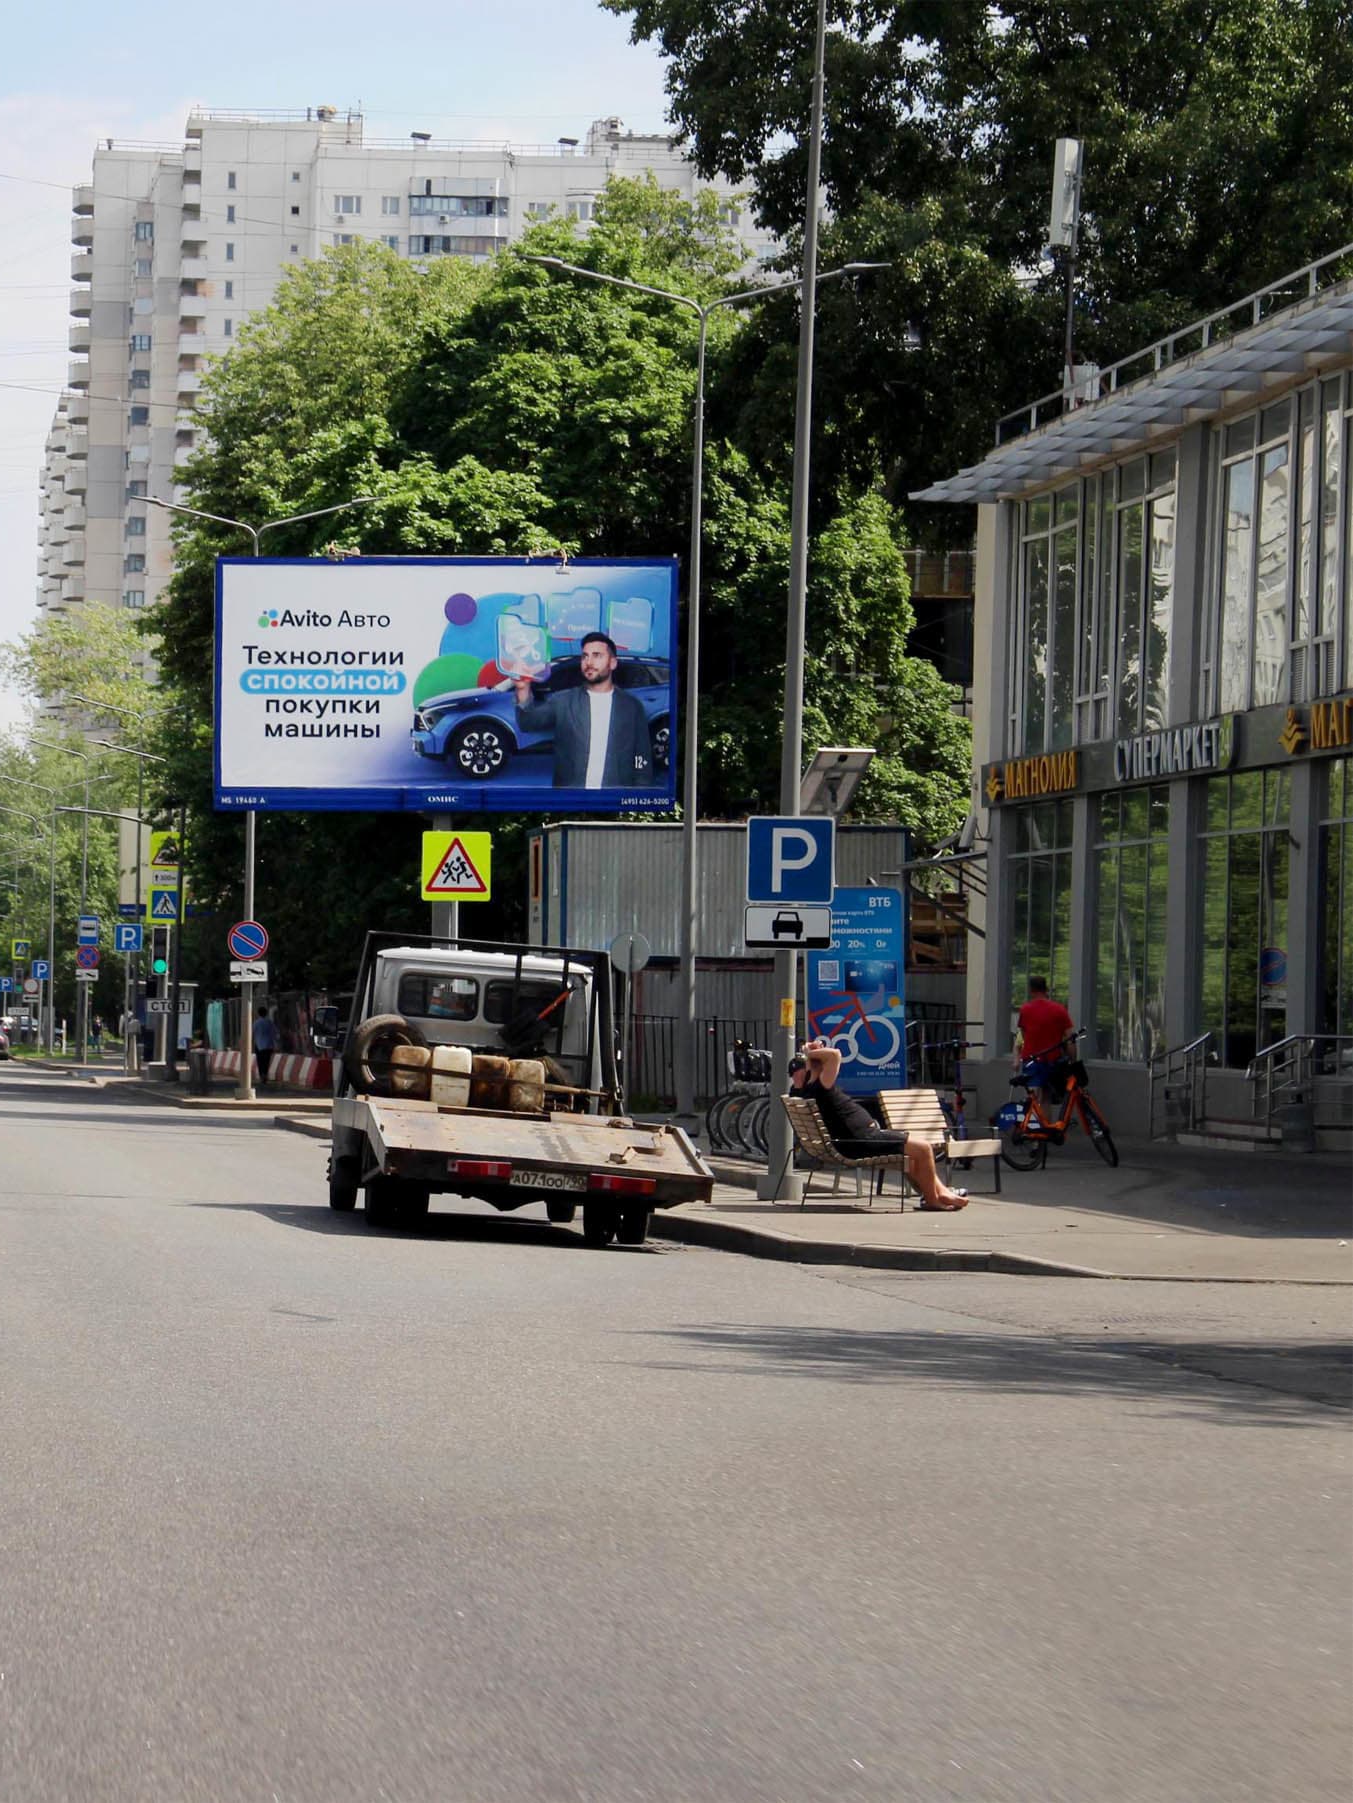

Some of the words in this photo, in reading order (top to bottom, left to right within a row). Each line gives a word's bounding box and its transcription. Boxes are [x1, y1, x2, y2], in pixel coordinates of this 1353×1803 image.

[280, 609, 332, 627] Avito
[337, 610, 391, 628] Авто
[242, 645, 405, 665] Технологии
[247, 669, 399, 690] спокойной
[265, 699, 381, 719] покупки
[264, 723, 381, 738] машины
[634, 755, 648, 769] 12+
[1113, 722, 1220, 782] СУПЕРМАРКЕТ
[1004, 750, 1078, 799] МАГНОЛИЯ
[771, 827, 818, 893] P
[869, 896, 892, 908] ВТБ
[122, 927, 137, 949] P
[37, 962, 48, 978] P
